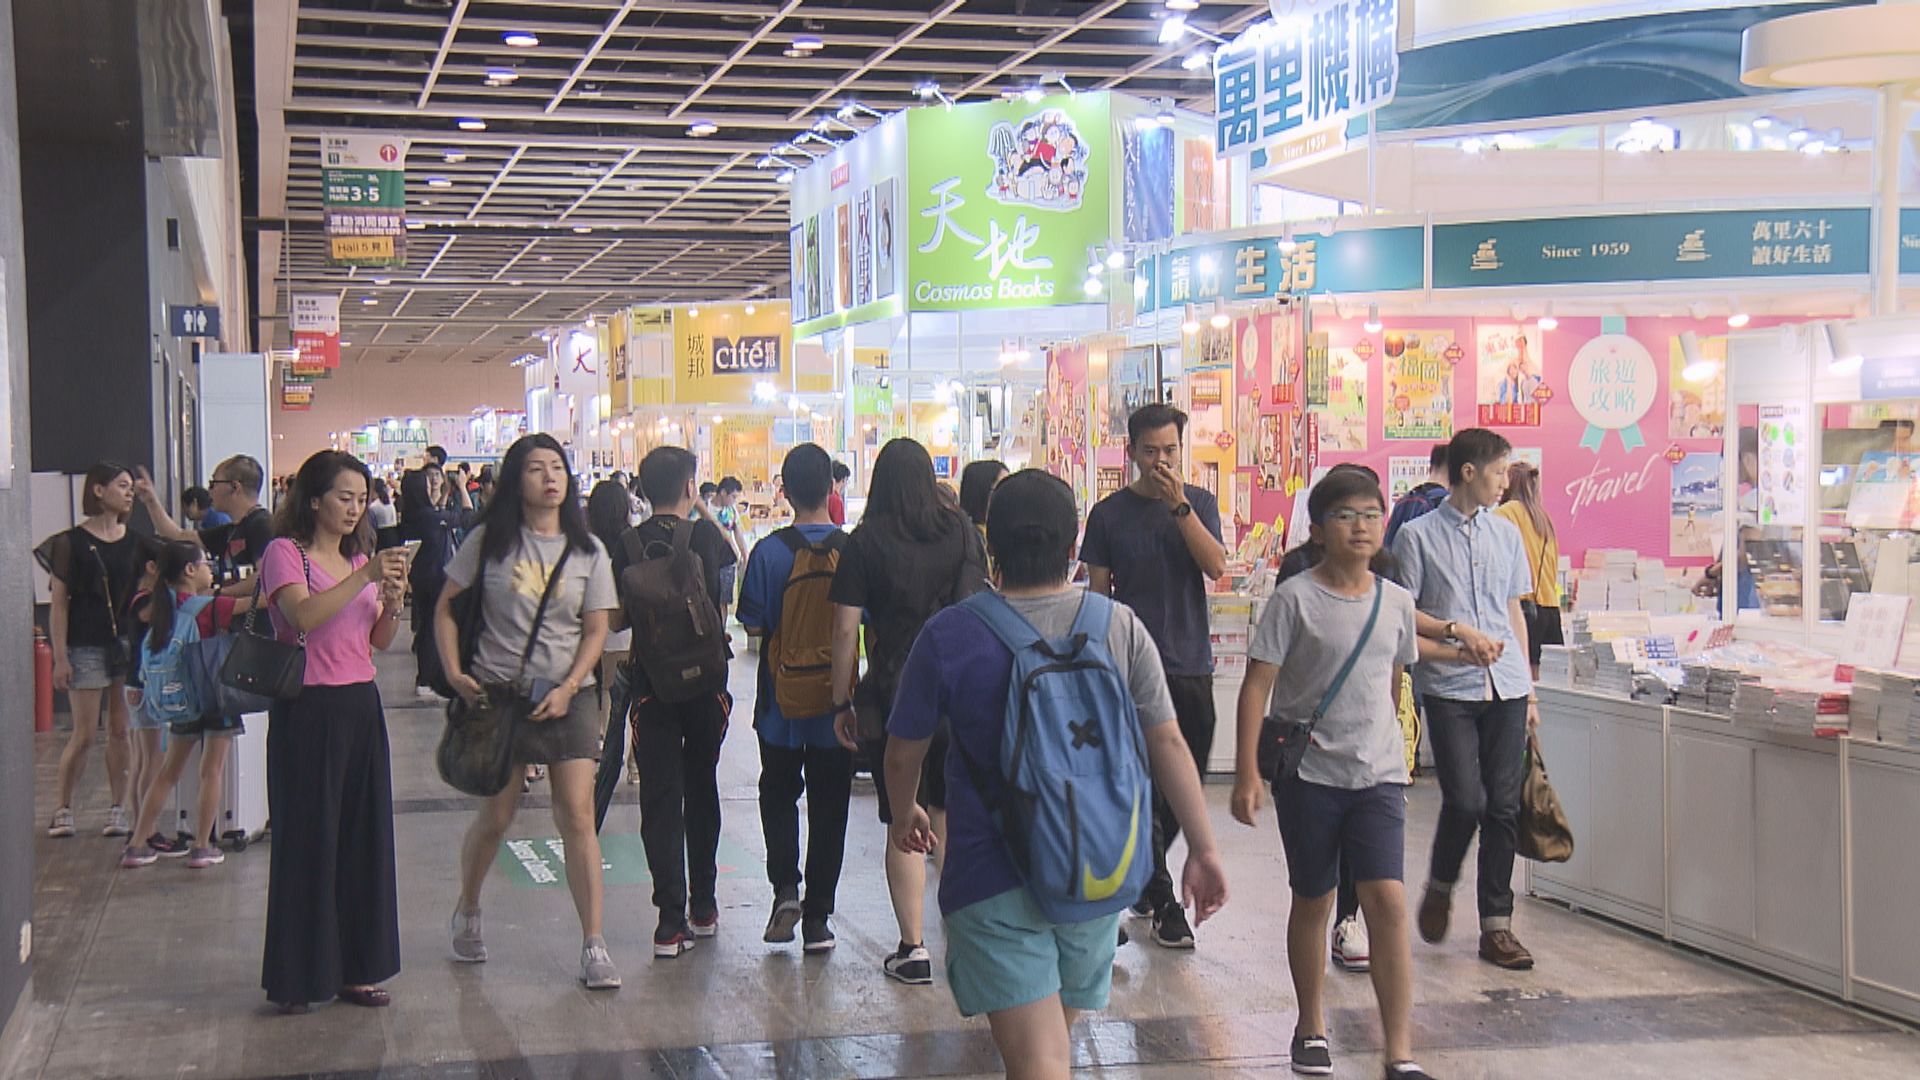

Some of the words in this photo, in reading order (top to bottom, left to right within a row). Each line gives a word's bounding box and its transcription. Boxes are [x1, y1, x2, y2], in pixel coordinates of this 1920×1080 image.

[918, 176, 1053, 280] 天地
[1752, 219, 1832, 241] 萬里六十
[337, 243, 359, 254] Hall
[1541, 244, 1582, 259] Since
[1591, 242, 1630, 257] 1959
[914, 281, 993, 303] Cosmos
[998, 275, 1054, 298] Books
[687, 333, 705, 379] 城邦
[715, 339, 764, 370] cité
[1588, 386, 1637, 413] 攻略
[1565, 448, 1668, 527] Travel
